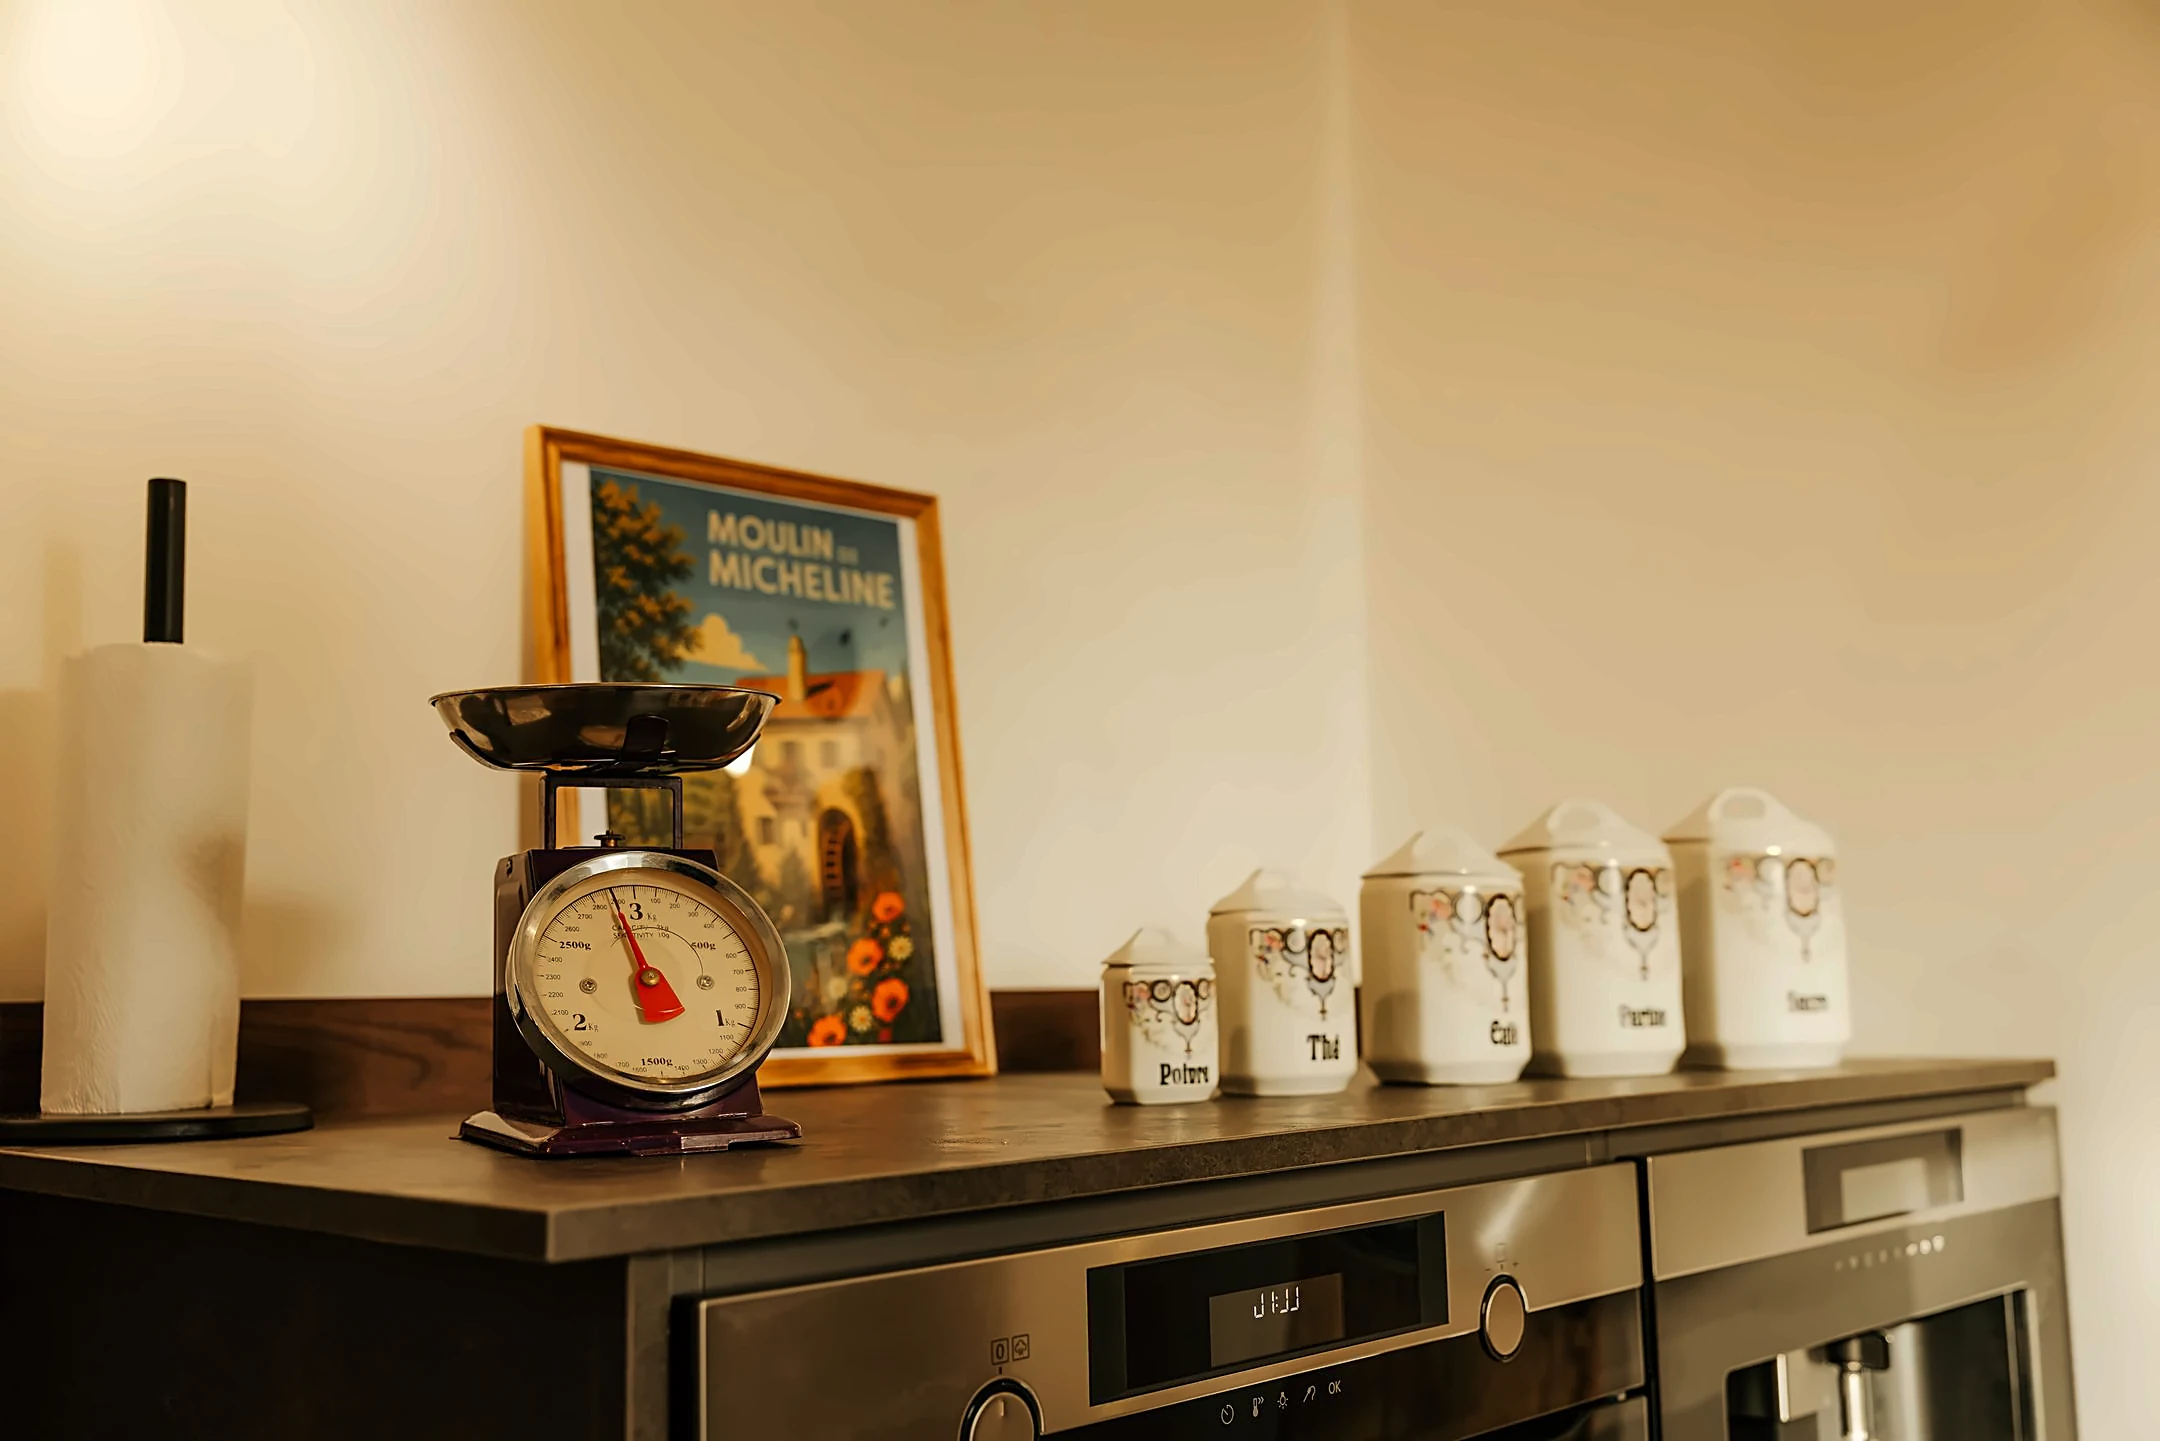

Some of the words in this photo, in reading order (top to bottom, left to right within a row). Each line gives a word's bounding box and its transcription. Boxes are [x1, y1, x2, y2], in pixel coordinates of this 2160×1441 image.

[708, 509, 833, 561] MOULIN
[709, 549, 896, 610] MICHELINE
[629, 903, 643, 920] 3
[559, 940, 592, 951] 2500g
[691, 941, 717, 951] 500g
[572, 1013, 587, 1031] 2
[641, 1057, 673, 1067] 1500g
[1328, 1380, 1342, 1395] OK
